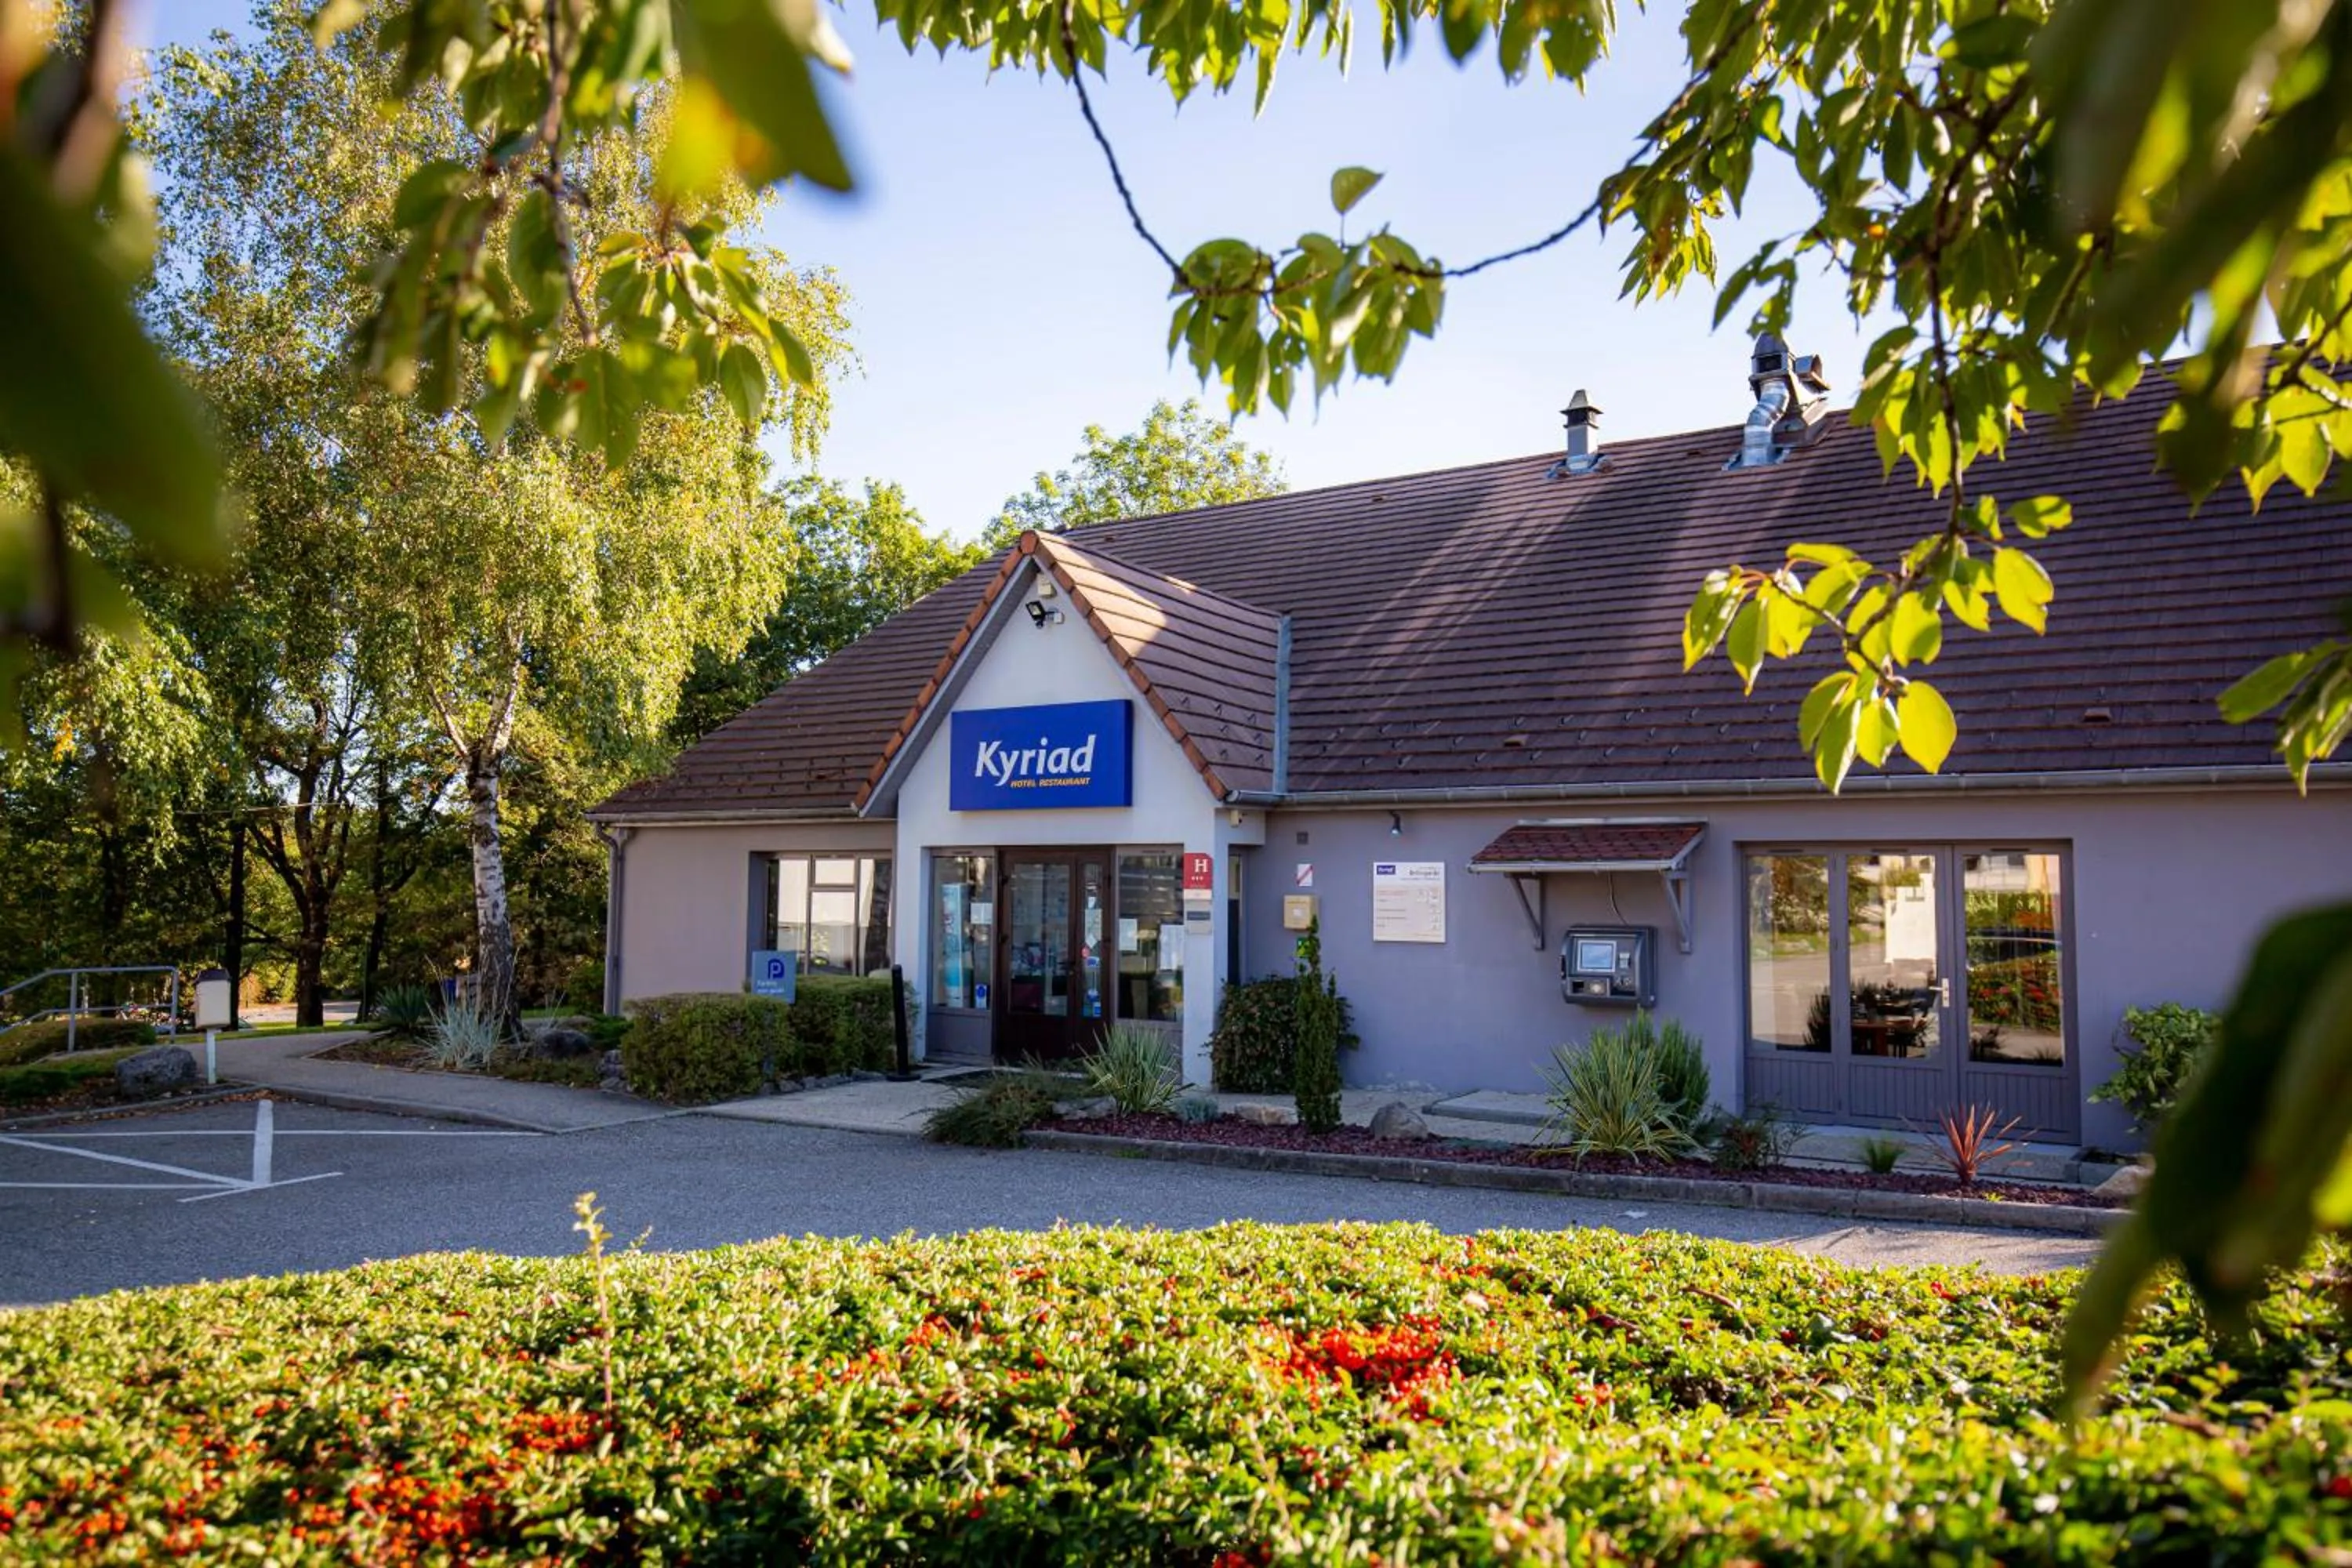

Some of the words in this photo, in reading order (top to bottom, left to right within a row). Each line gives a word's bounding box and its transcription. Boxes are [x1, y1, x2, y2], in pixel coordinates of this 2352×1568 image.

[975, 734, 1097, 786] Kyriad
[1011, 780, 1035, 789] HOTEL
[1040, 777, 1091, 787] RESTAURANT
[1195, 858, 1208, 872] H
[769, 960, 782, 979] P
